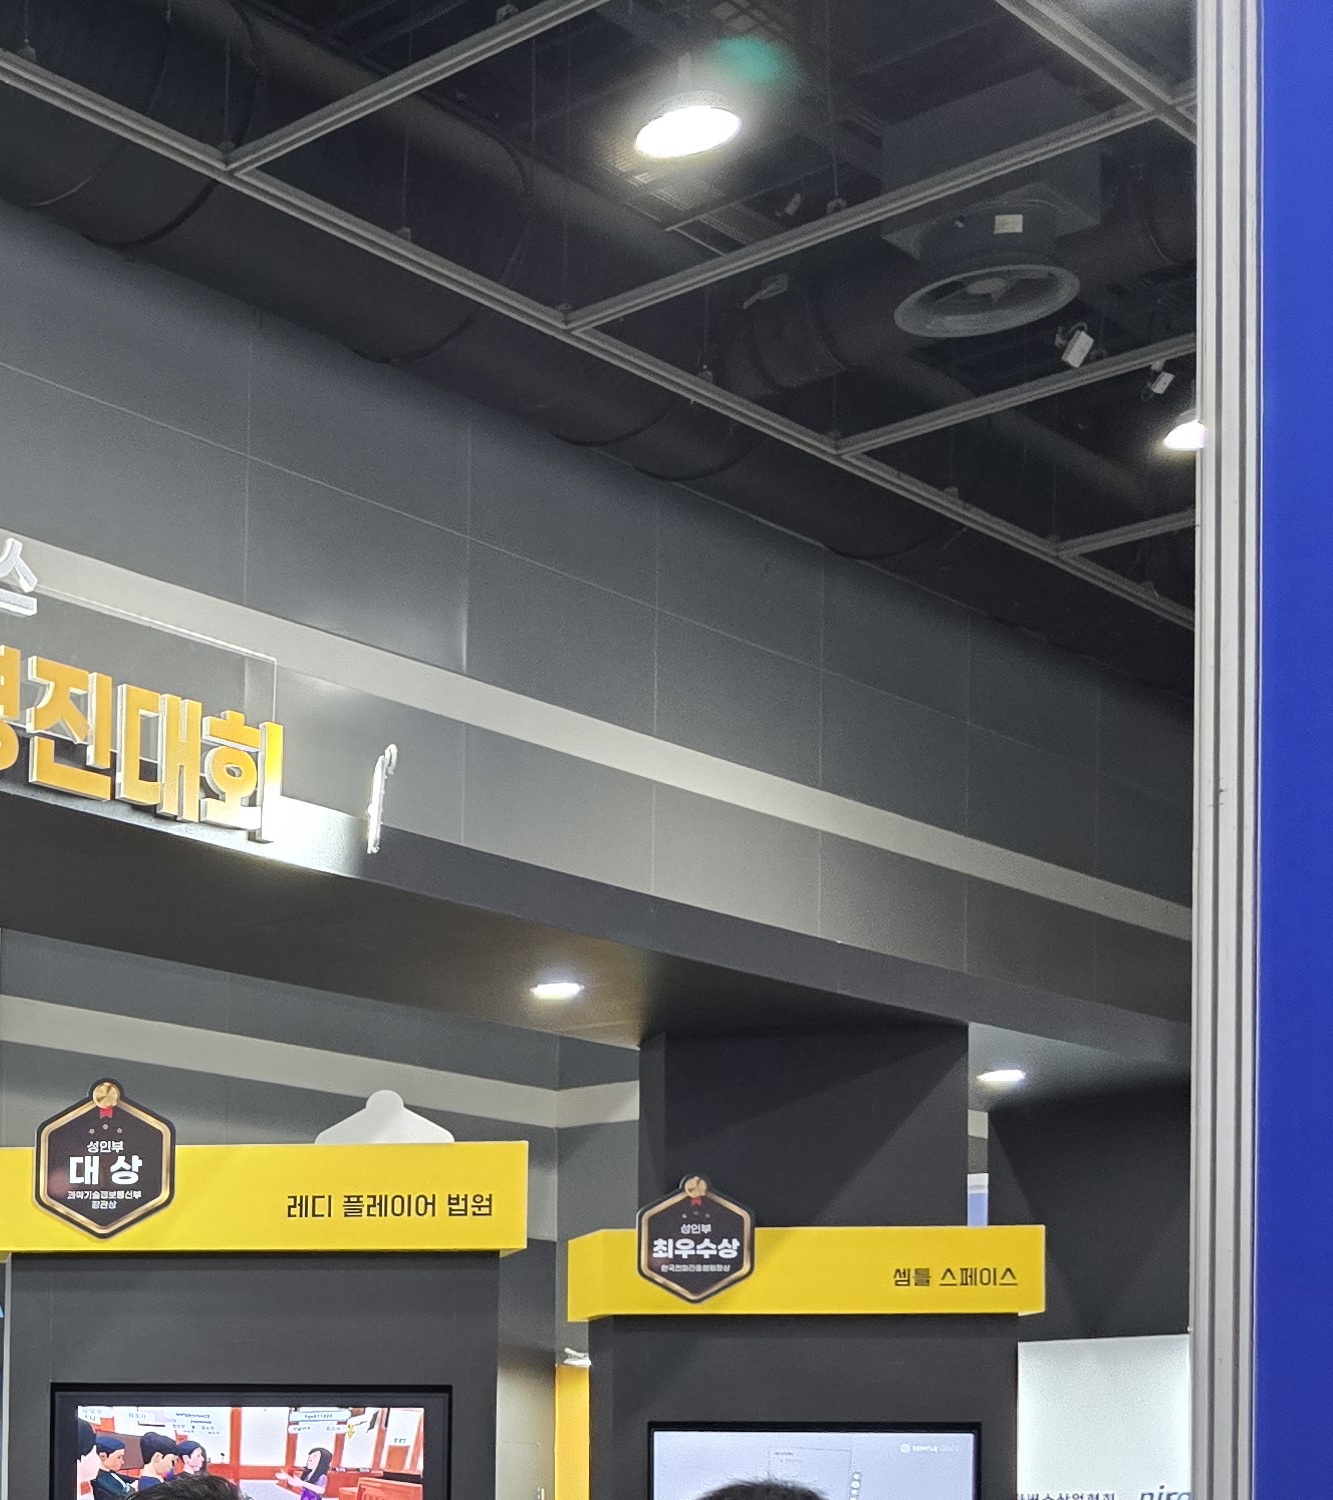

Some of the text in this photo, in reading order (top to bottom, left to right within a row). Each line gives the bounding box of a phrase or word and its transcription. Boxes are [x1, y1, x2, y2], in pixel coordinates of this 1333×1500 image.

[87, 1141, 124, 1153] 성인부
[286, 1192, 493, 1218] 레디 플레이어 법원
[680, 1223, 712, 1235] 성인부
[652, 1238, 740, 1259] 최우수상
[939, 1267, 1019, 1287] 스페이스
